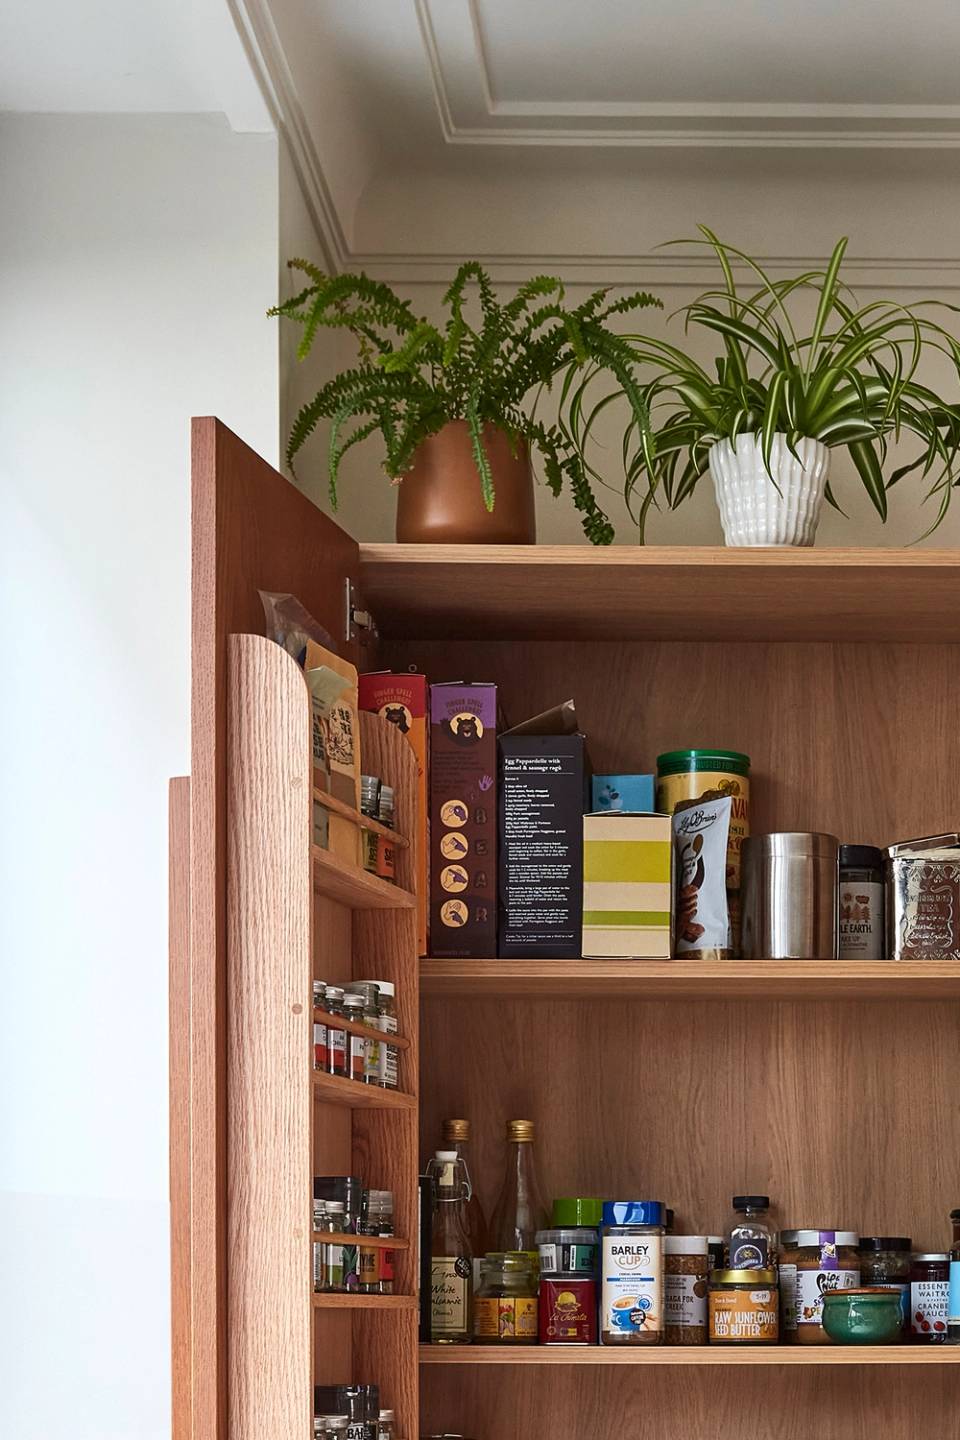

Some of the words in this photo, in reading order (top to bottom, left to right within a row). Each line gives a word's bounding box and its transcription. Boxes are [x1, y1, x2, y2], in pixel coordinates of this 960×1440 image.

[850, 923, 872, 934] EARTH
[612, 1246, 649, 1256] BARLEY
[619, 1256, 641, 1266] CUP
[431, 1297, 461, 1306] alsamic
[715, 1312, 731, 1324] RAW
[730, 1324, 761, 1336] BUTTER
